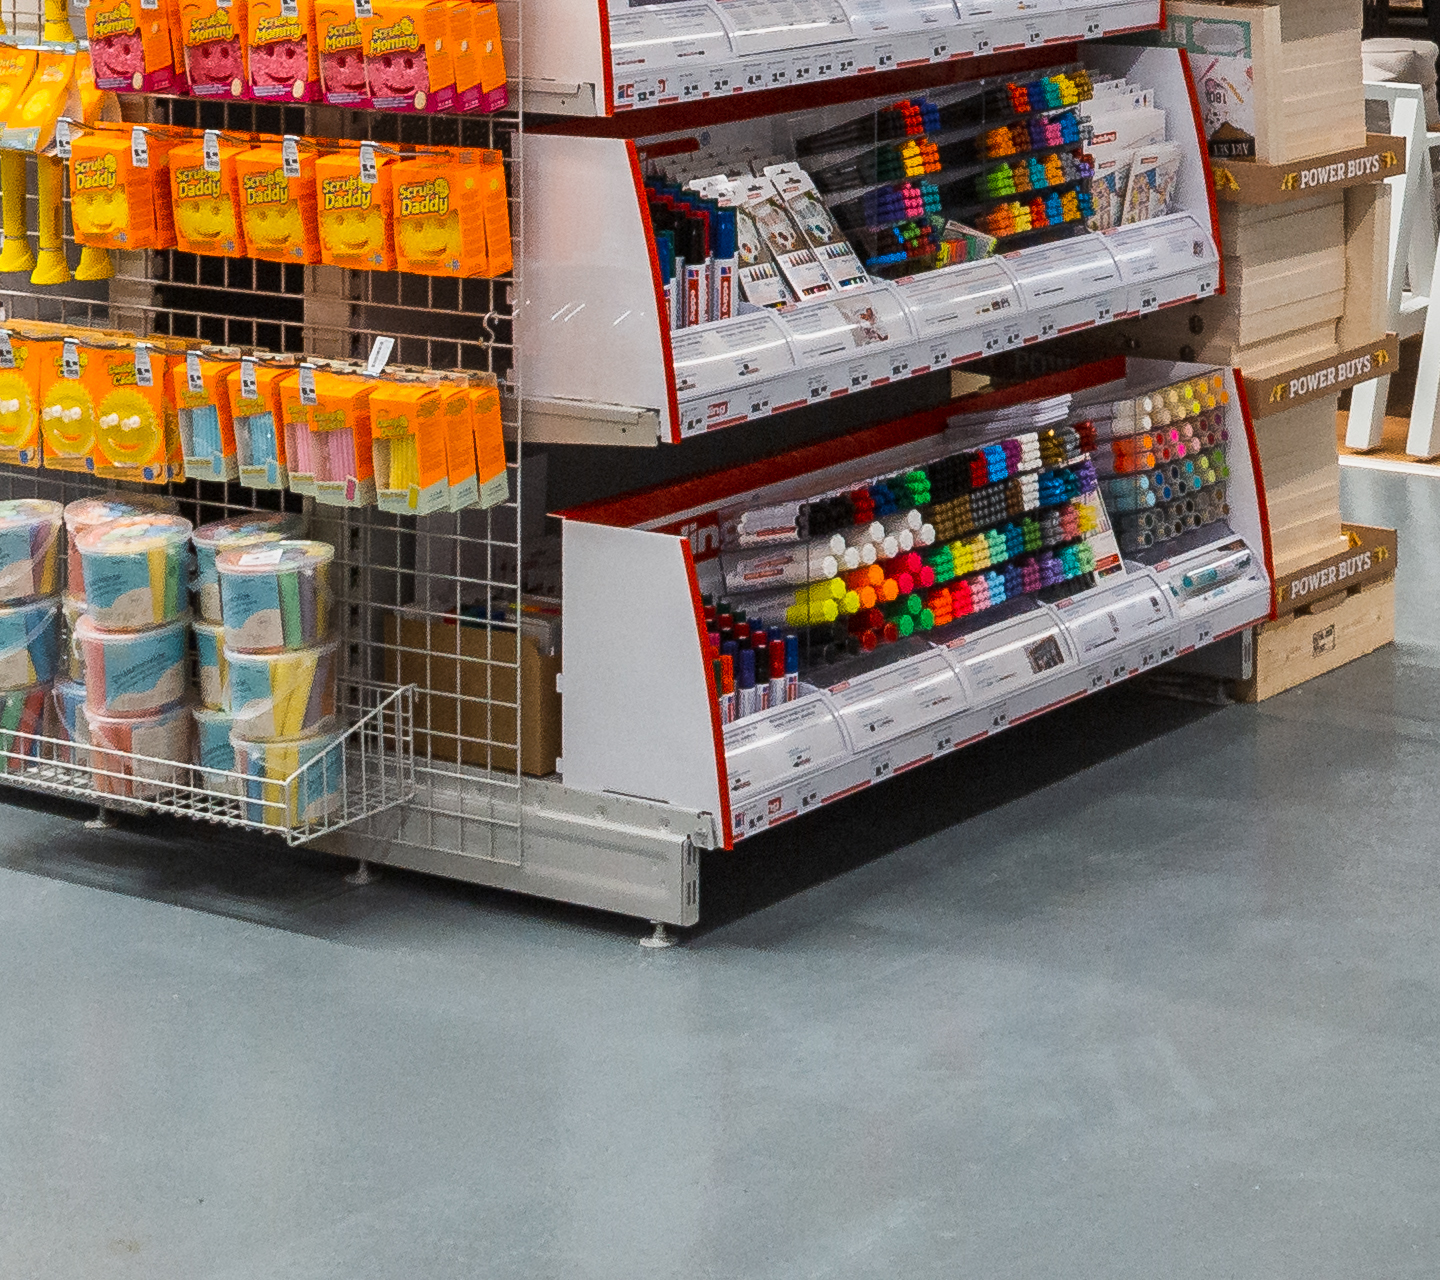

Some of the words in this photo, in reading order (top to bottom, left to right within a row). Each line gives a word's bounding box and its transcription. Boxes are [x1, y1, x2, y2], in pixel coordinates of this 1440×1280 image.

[74, 158, 106, 174] Scrub
[1299, 165, 1346, 189] POWER
[1346, 155, 1380, 181] BUYS
[76, 171, 118, 190] Daddy
[175, 168, 208, 184] Scrub
[243, 172, 276, 190] Scrub
[178, 178, 222, 199] Daddy
[246, 185, 288, 204] Daddy
[322, 178, 357, 195] Scrub
[399, 183, 436, 200] Scrub
[323, 191, 371, 211] Daddy
[400, 196, 449, 217] Daddy
[1288, 369, 1338, 399] POWER
[1338, 355, 1372, 383] BUYS
[1290, 567, 1337, 600] POWER
[1338, 550, 1372, 582] BUYS
